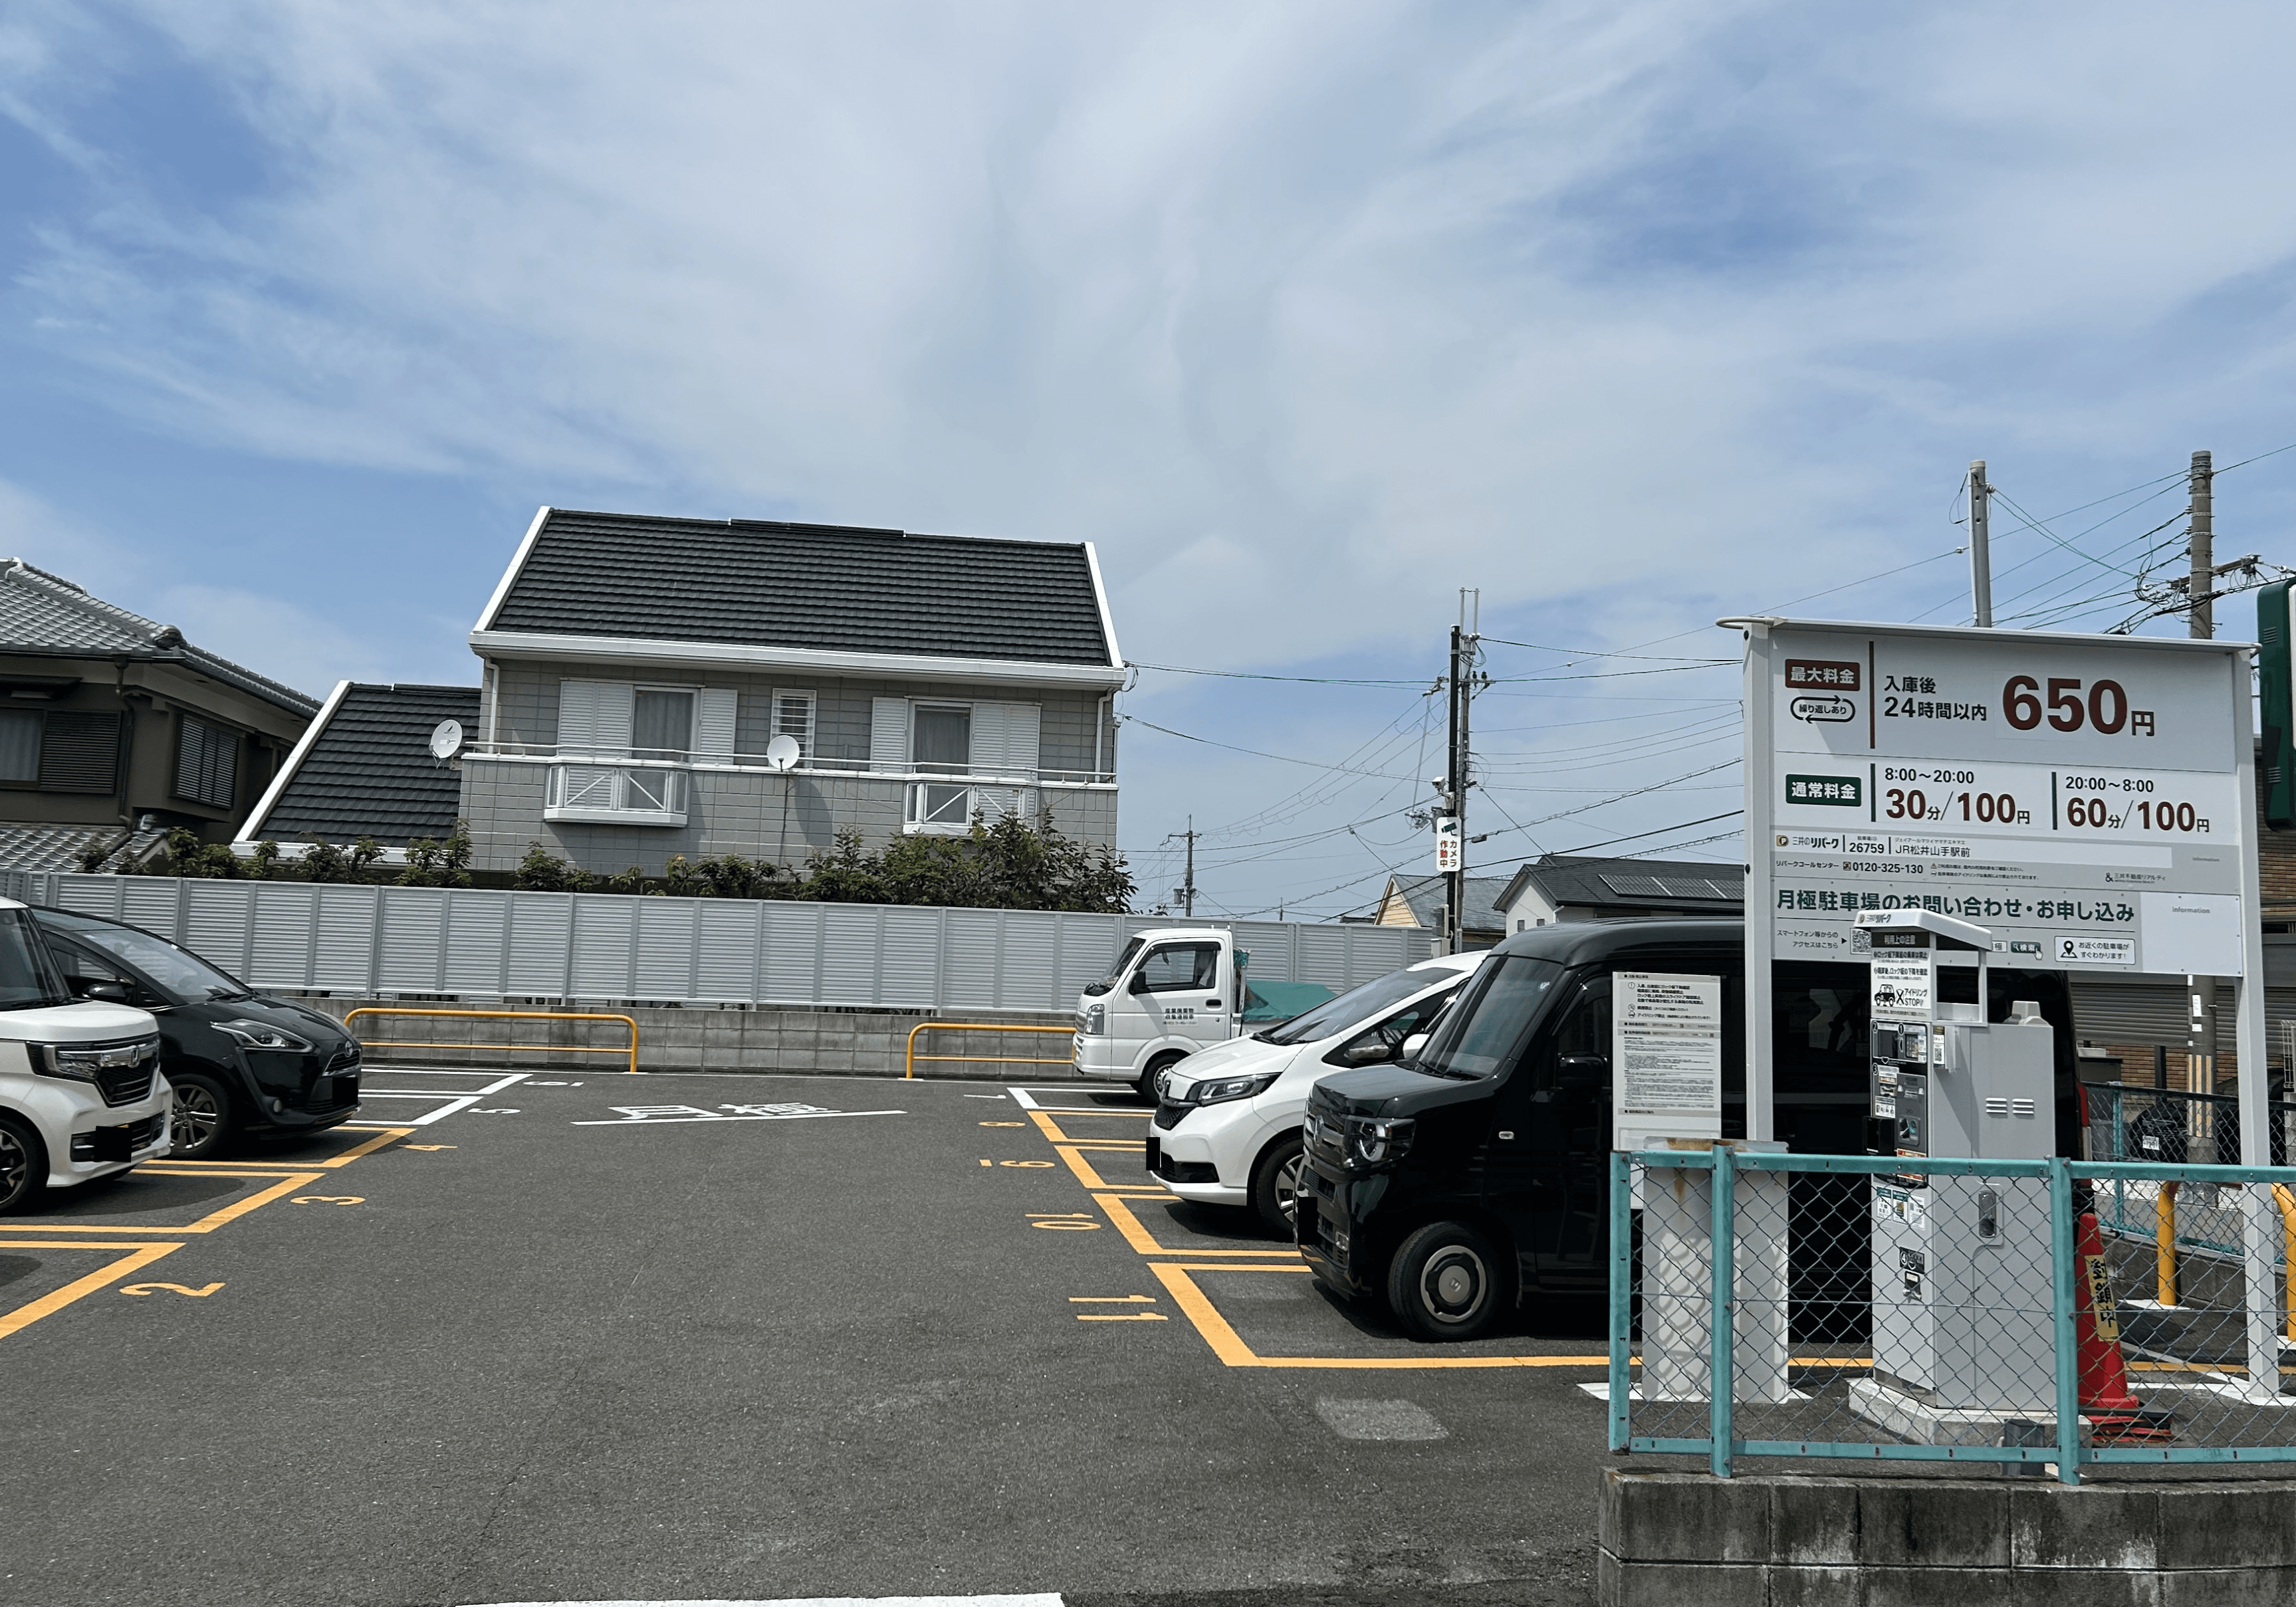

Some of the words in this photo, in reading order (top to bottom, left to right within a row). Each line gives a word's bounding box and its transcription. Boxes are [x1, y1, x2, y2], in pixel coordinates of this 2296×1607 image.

[1791, 666, 1855, 684] 最大料金
[1884, 675, 1936, 694] 入庫後
[1799, 704, 1847, 714] 繰り返しあり
[1884, 696, 1987, 721] 24時間以内
[2002, 675, 2154, 736] 650円
[1791, 782, 1855, 800] 通常料金
[1792, 837, 1839, 848] 三井のリパーク
[1849, 843, 1885, 854] 26759
[1895, 845, 1970, 857] JR松井山手駅前
[1853, 863, 1923, 873] 0120-325-130
[1777, 889, 2134, 922] 月極駐車場のお問い合わせ・お申し込み
[2019, 943, 2035, 952] 検索
[2078, 942, 2130, 950] お近くの駐車場が
[608, 1102, 842, 1120] 月極
[290, 1196, 366, 1206] 3
[1024, 1212, 1102, 1230] 10
[120, 1282, 226, 1297] 2
[1068, 1294, 1169, 1321] 11
